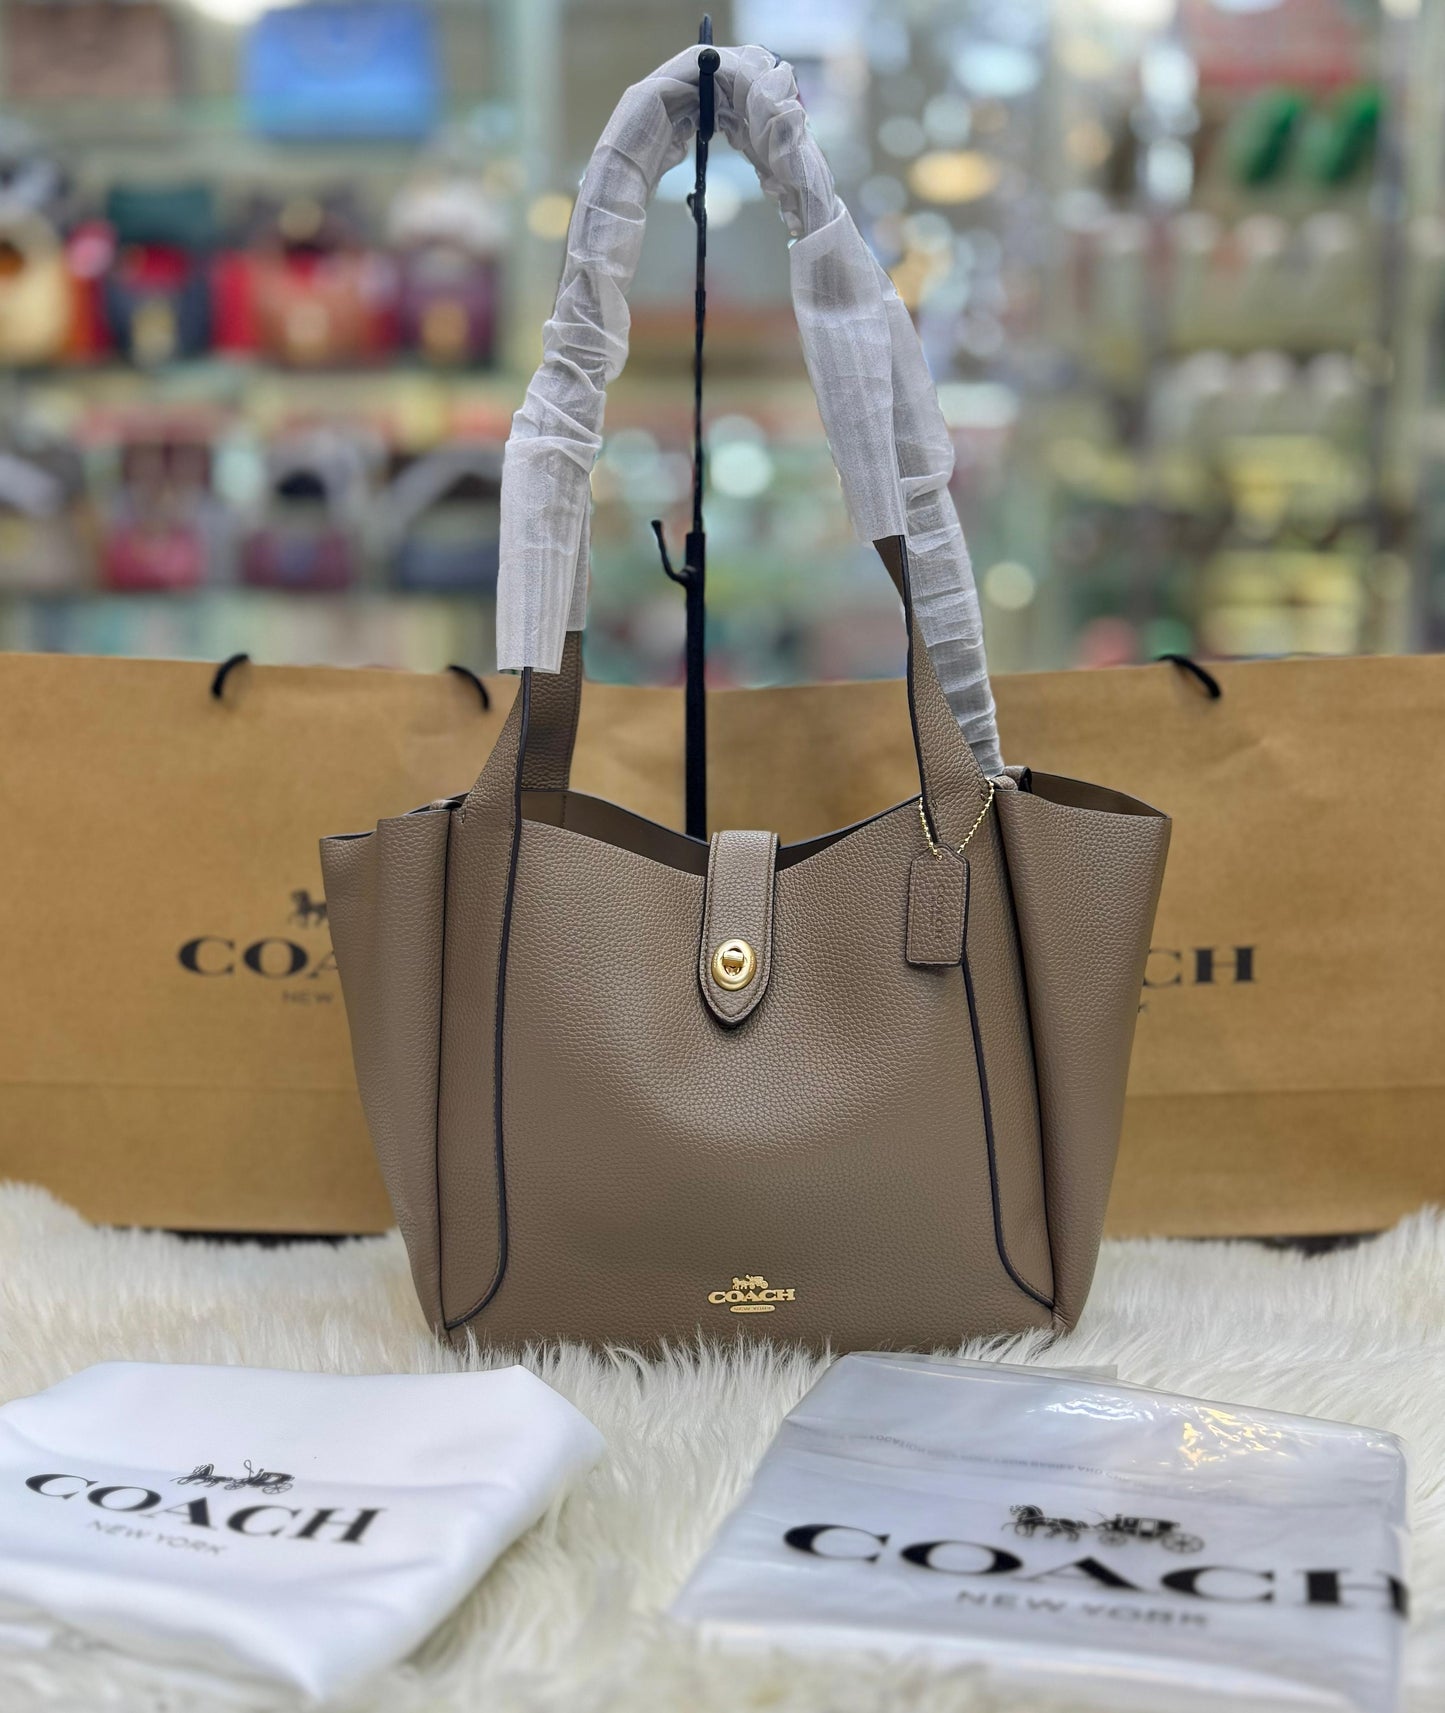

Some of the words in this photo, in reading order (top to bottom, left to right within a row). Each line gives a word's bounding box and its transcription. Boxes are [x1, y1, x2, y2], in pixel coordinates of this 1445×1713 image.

[1142, 945, 1258, 988] CH
[708, 1288, 795, 1304] COACH
[25, 1473, 387, 1545] COACH
[88, 1519, 152, 1538] NEW
[155, 1533, 227, 1555] YORK
[783, 1522, 1410, 1621] COACH
[956, 1590, 1066, 1613] NEW
[1083, 1603, 1208, 1625] YORK
